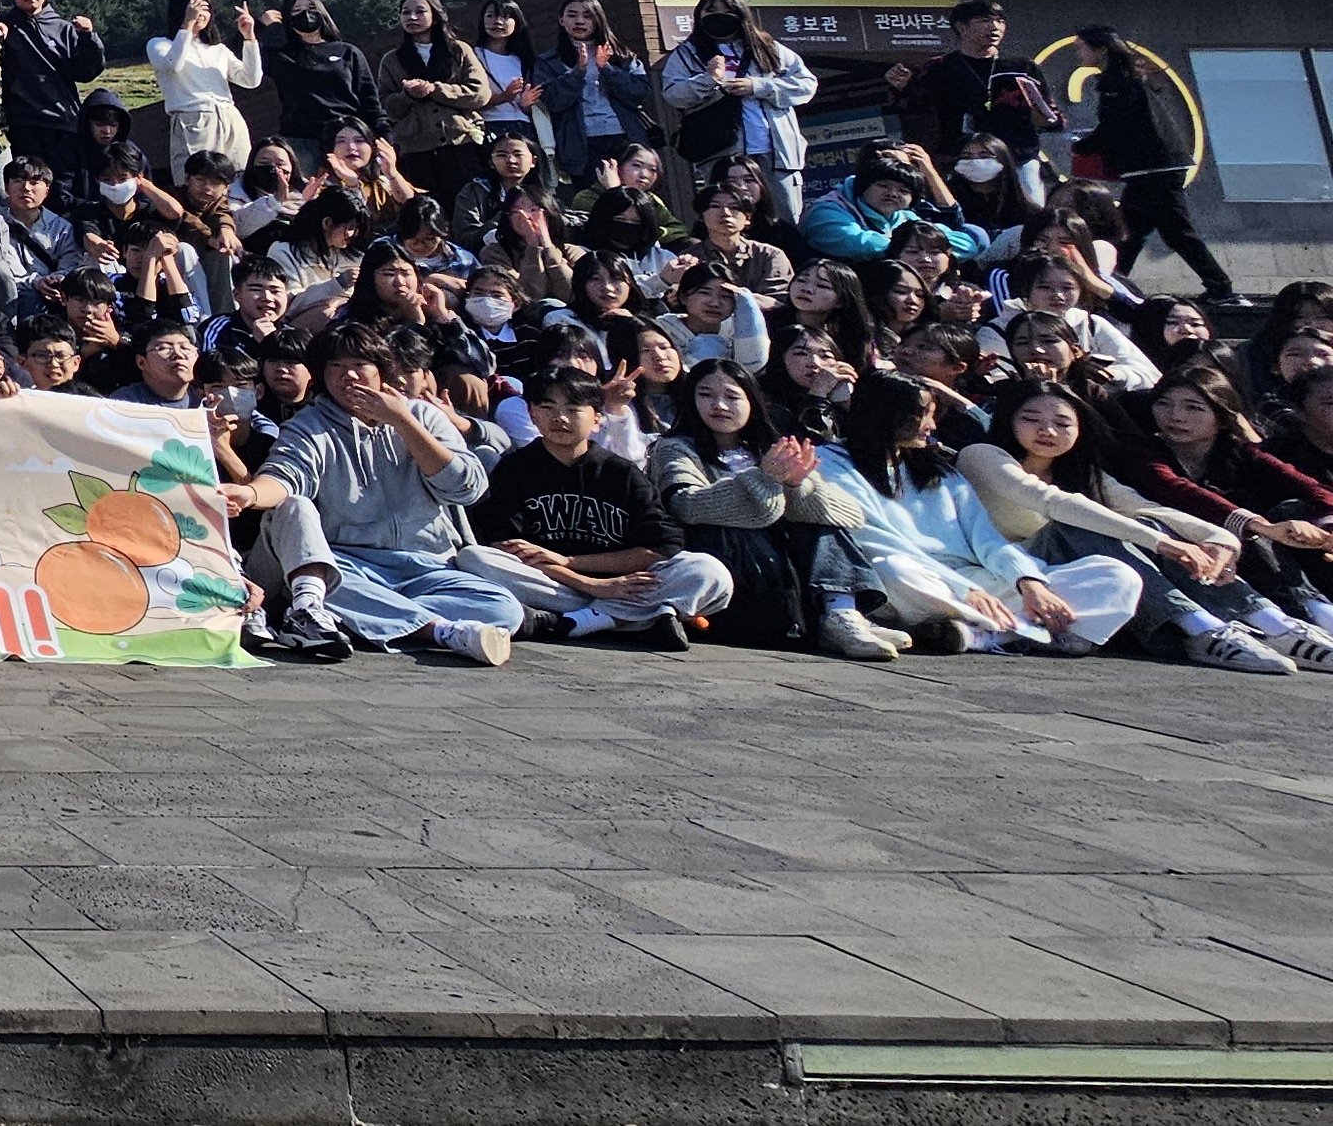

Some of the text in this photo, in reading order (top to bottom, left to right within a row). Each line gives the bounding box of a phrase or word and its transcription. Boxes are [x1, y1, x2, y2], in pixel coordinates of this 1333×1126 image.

[783, 15, 838, 33] 홍보관
[874, 13, 951, 30] 관리사무소
[539, 531, 610, 548] NIVERSITY
